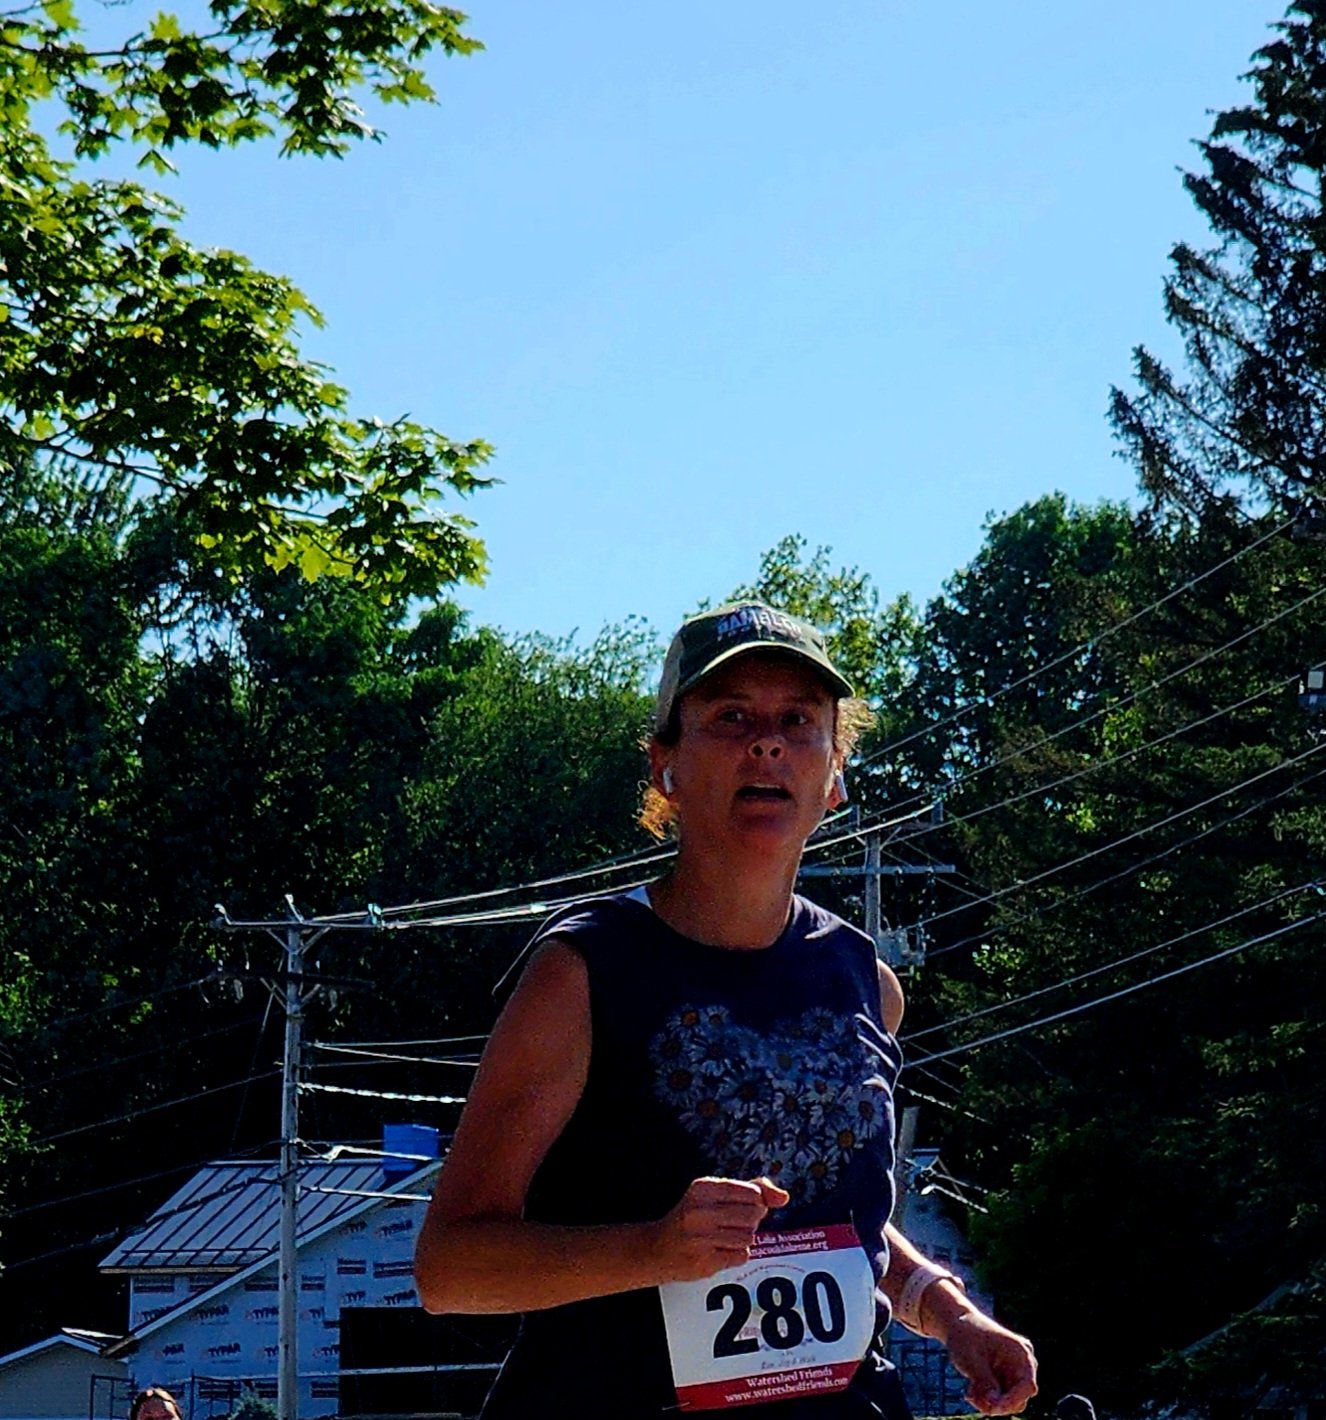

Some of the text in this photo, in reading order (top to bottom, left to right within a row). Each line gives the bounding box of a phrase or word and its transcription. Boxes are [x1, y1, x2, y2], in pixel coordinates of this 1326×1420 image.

[706, 1271, 846, 1359] 280
[725, 1377, 849, 1402] www.watershedfriends.com
[746, 1366, 833, 1388] Watershed Friends
